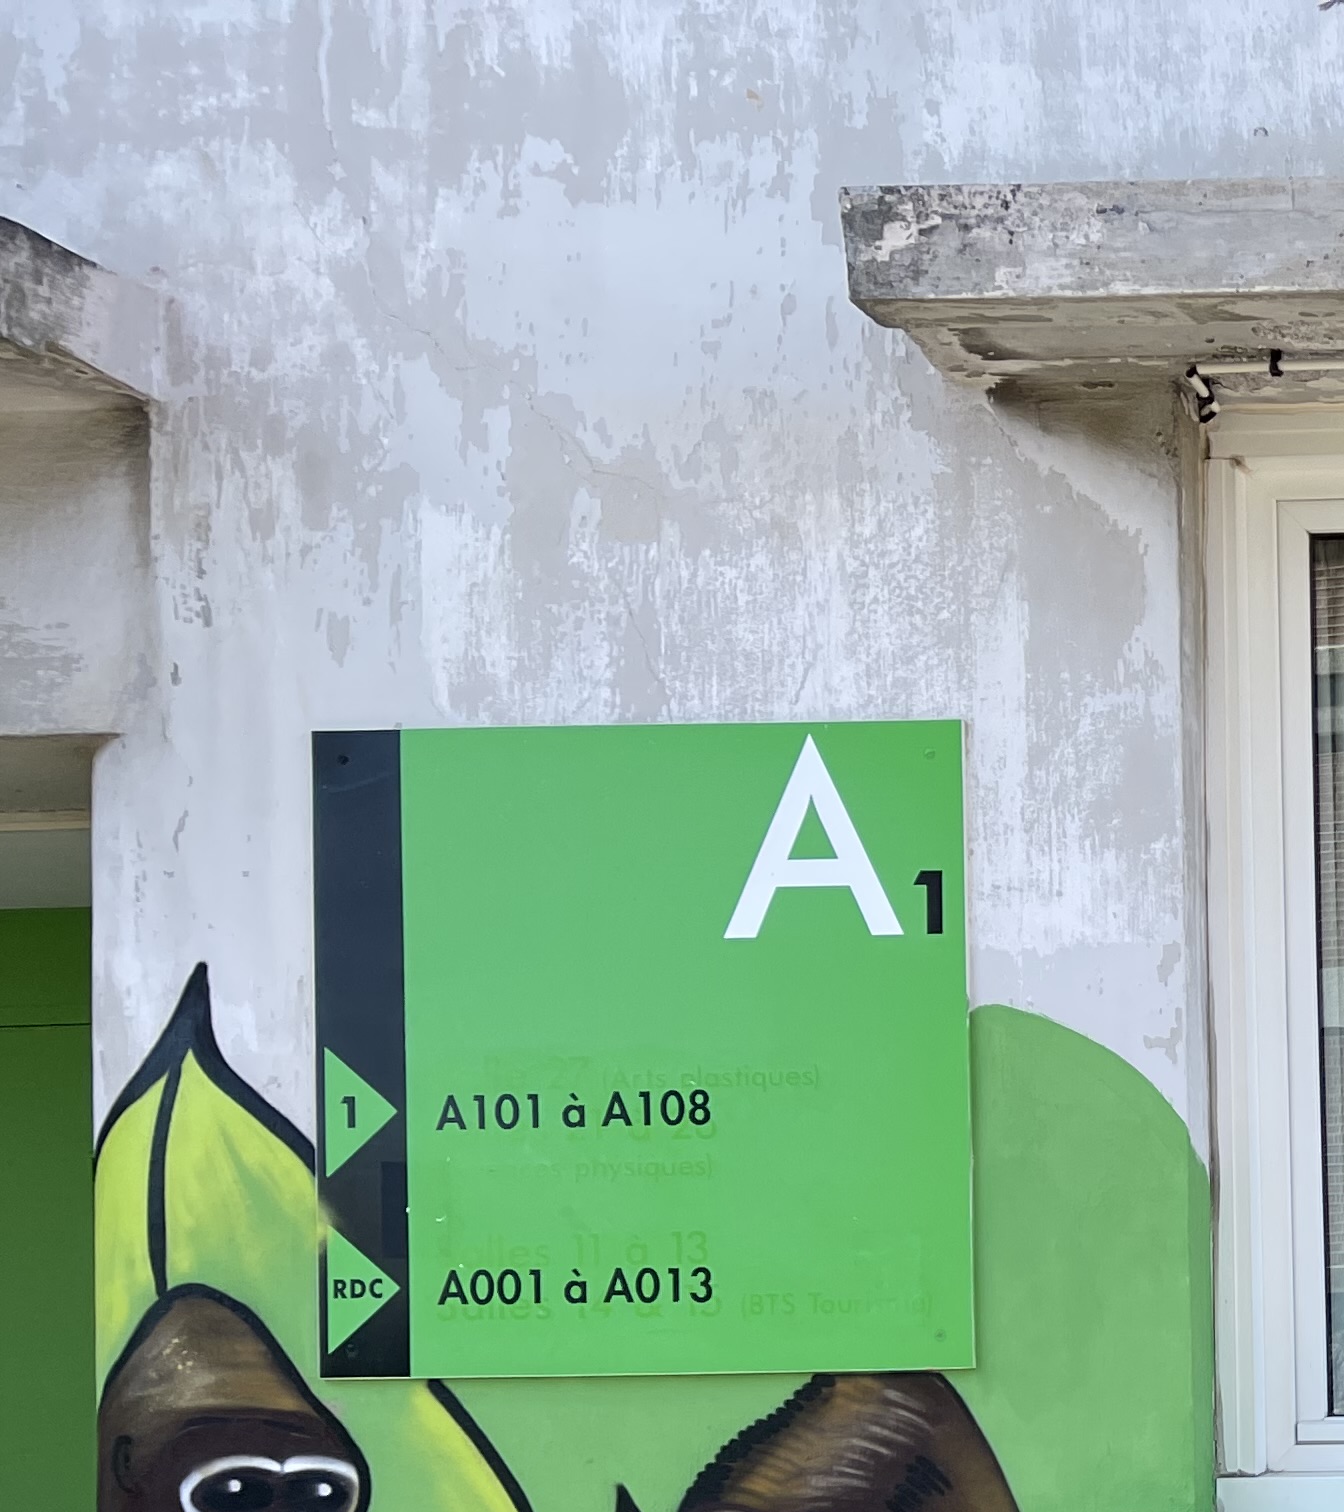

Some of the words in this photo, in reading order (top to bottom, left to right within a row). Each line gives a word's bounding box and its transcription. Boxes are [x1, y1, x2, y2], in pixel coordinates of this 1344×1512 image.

[341, 1096, 359, 1129] 1
[435, 1093, 542, 1131] A101
[562, 1092, 587, 1128] à
[601, 1089, 711, 1127] A108
[333, 1278, 384, 1299] RDC
[437, 1268, 544, 1306] A001
[564, 1268, 589, 1304] à
[603, 1266, 713, 1304] A013
